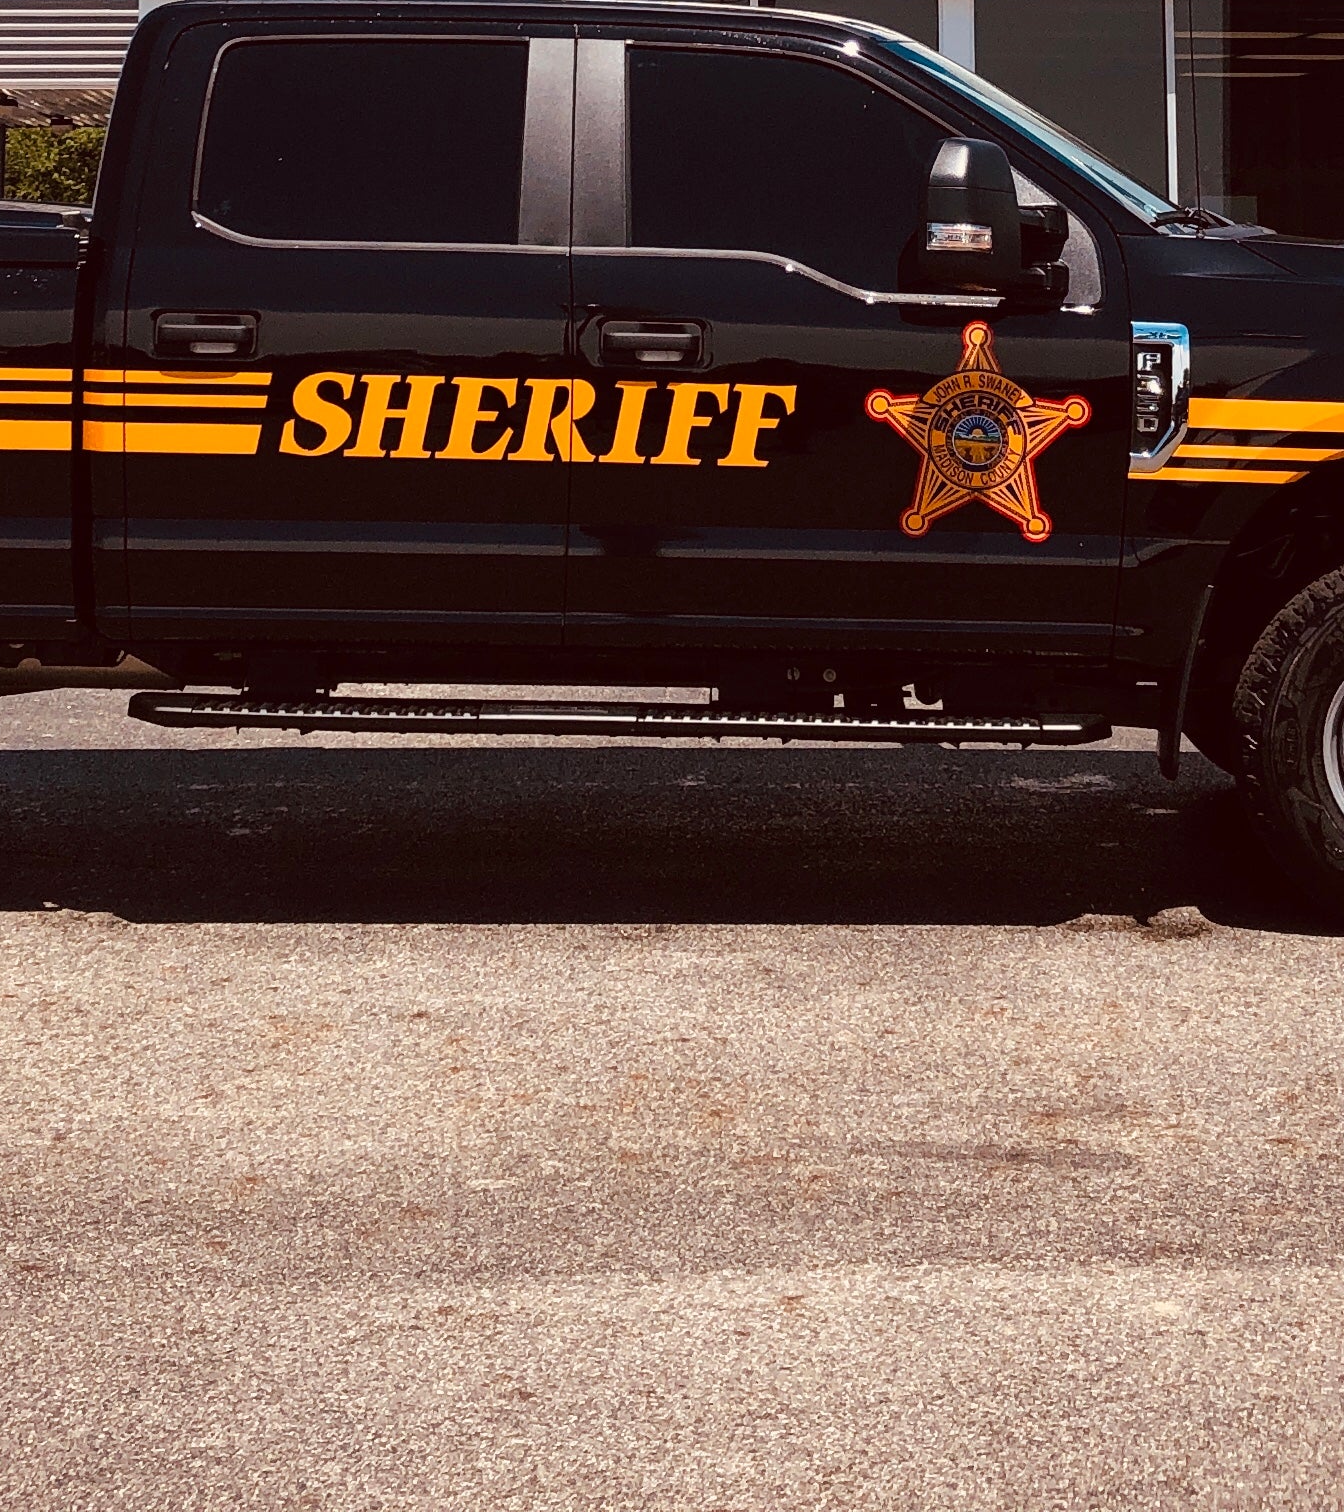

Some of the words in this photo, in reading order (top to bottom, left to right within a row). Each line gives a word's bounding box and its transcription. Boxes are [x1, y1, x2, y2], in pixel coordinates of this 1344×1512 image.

[932, 377, 961, 403] JOHN
[978, 373, 1026, 405] SWANEY
[279, 371, 798, 468] SHERIFF
[933, 395, 1023, 436] SHERIFF
[933, 444, 974, 485] MADISON
[980, 447, 1022, 486] COUNTY
